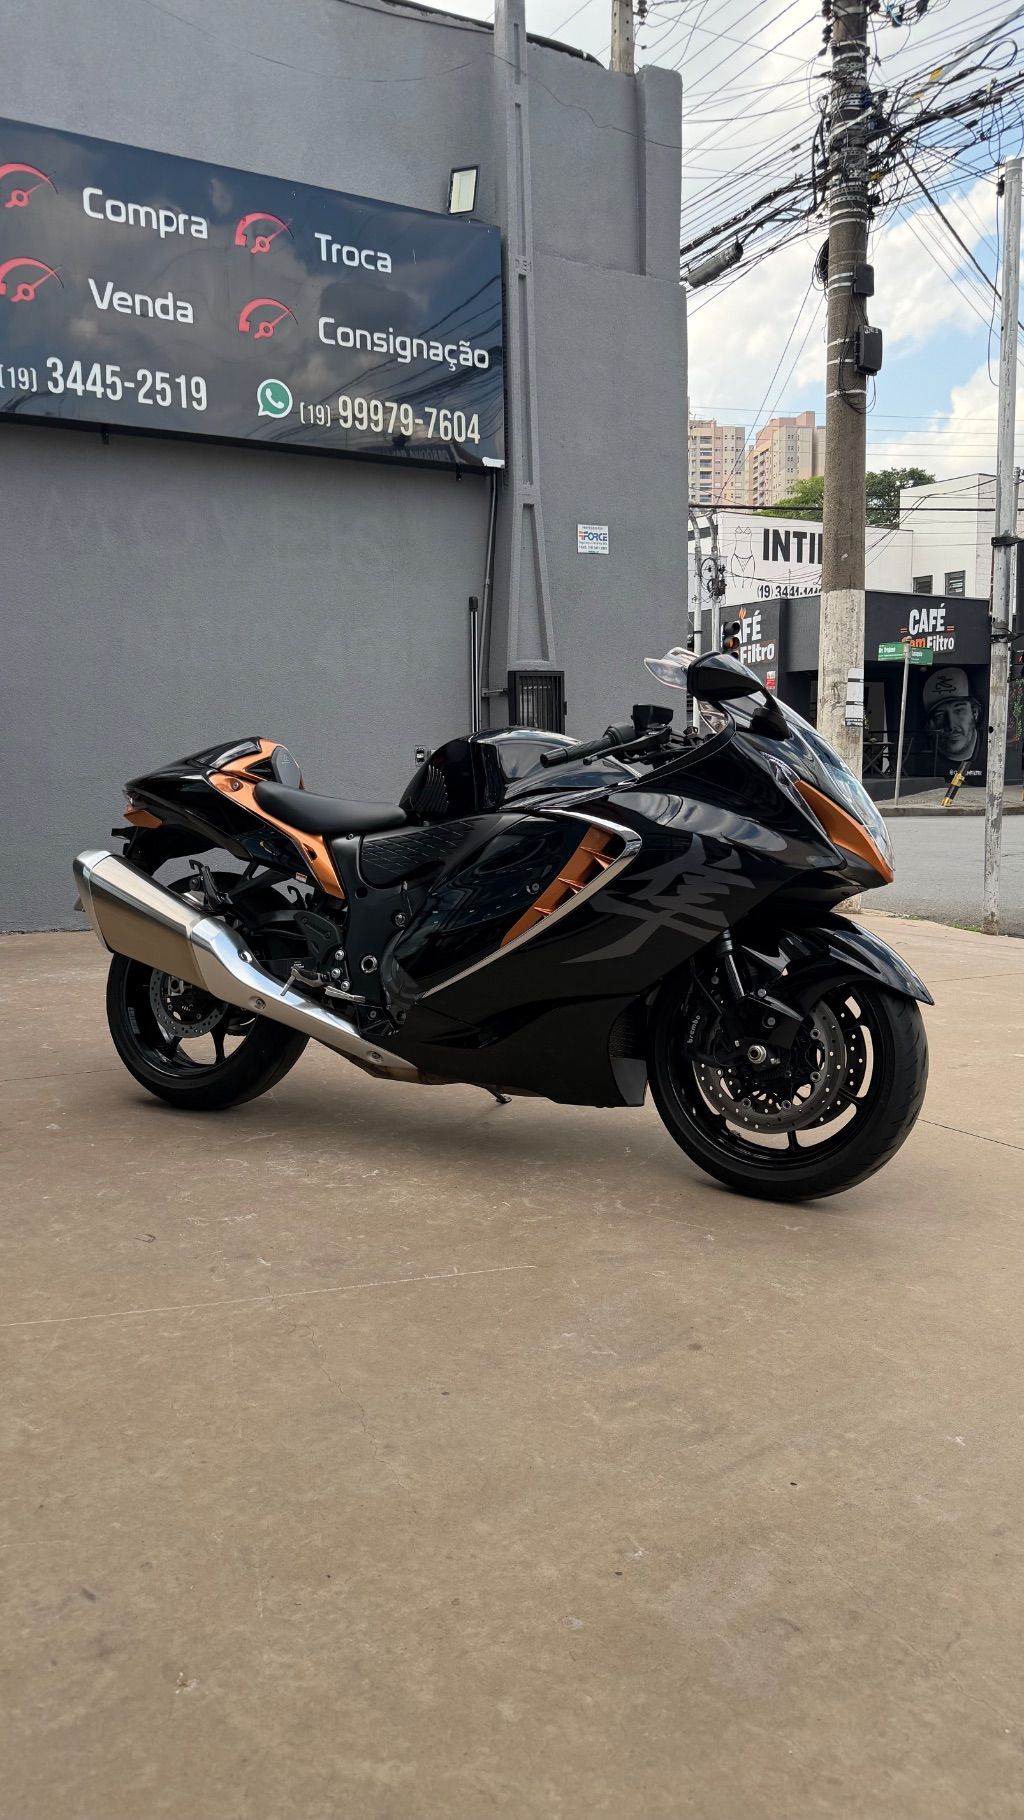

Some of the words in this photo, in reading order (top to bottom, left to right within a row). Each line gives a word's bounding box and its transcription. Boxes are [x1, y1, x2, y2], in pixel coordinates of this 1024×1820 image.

[82, 187, 208, 239] Compra
[314, 232, 392, 273] Troca
[87, 278, 194, 324] Venda
[318, 316, 489, 371] Consignação
[0, 364, 37, 392] (19)
[46, 356, 207, 411] 3445-2519
[300, 402, 331, 427] (19)
[338, 395, 481, 445] 99979-7604
[763, 528, 823, 564] INTI
[757, 584, 773, 599] (19)
[908, 602, 946, 635] CAFÉ
[740, 643, 775, 665] Filtro
[926, 634, 955, 652] Filtro
[686, 1015, 701, 1044] brembo
